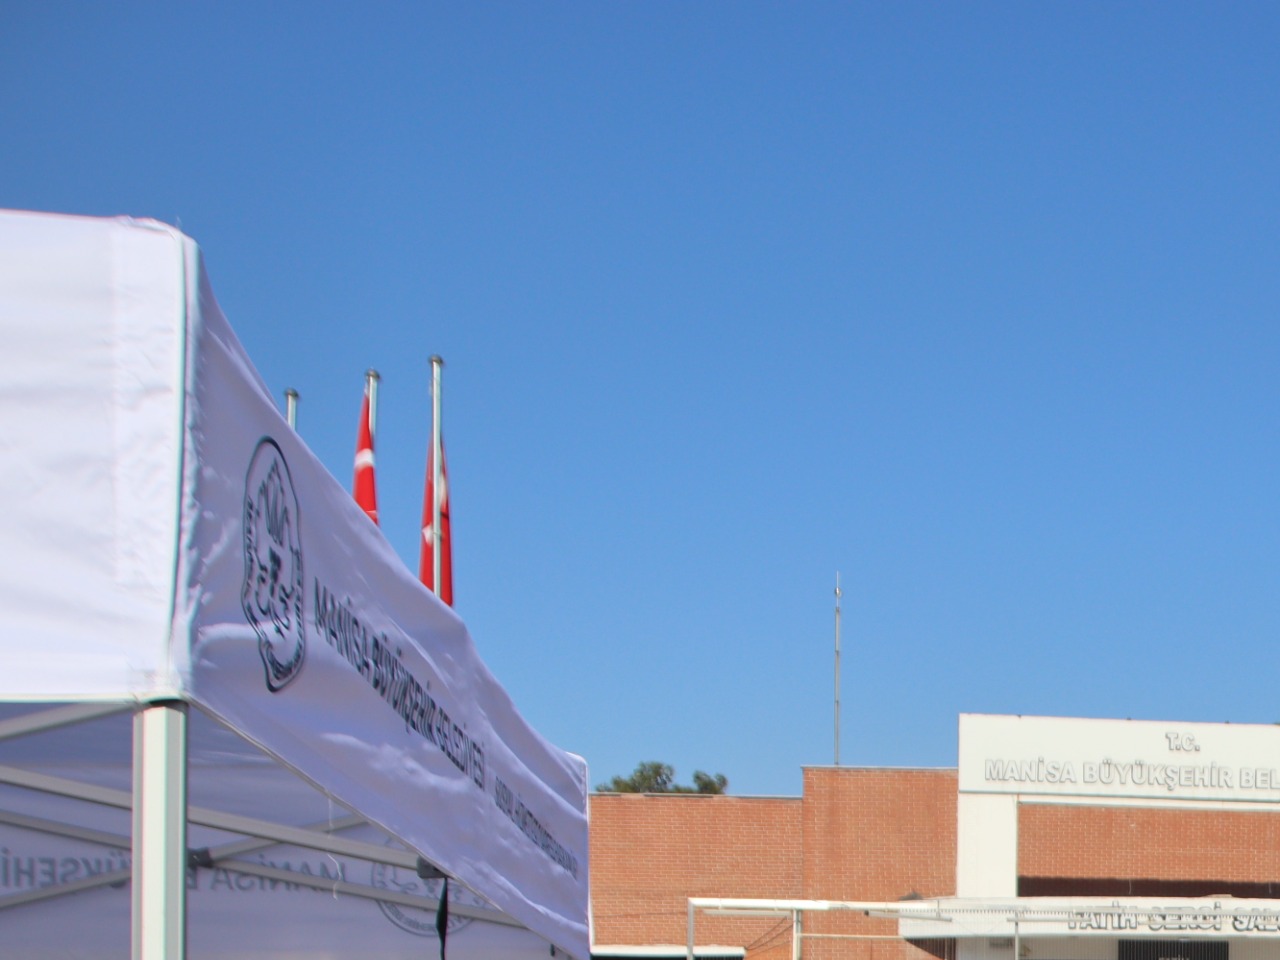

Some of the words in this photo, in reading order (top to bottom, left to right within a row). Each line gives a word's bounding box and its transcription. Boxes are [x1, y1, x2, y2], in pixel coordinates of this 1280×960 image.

[314, 575, 370, 682] MANİSA
[1165, 731, 1201, 752] T.C.
[985, 757, 1077, 783] MANİSA
[1083, 757, 1234, 791] BÜYÜKŞEHİR
